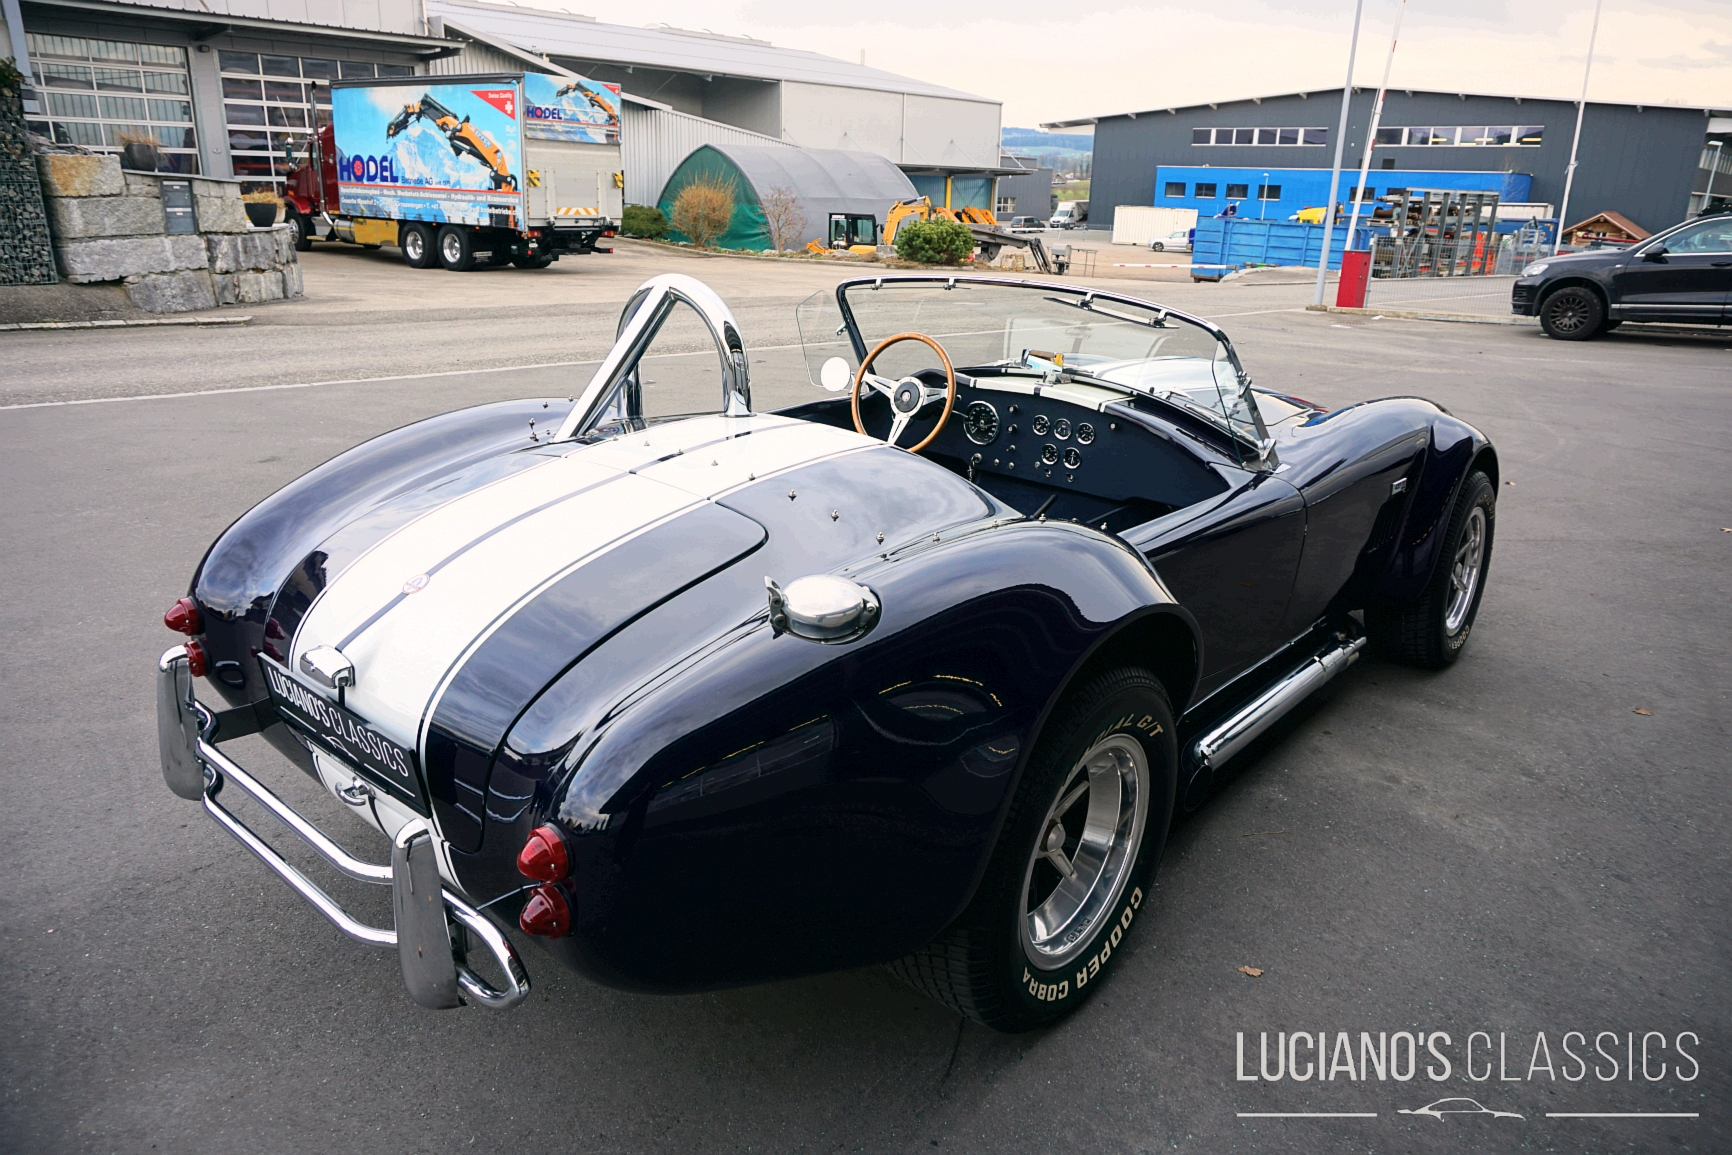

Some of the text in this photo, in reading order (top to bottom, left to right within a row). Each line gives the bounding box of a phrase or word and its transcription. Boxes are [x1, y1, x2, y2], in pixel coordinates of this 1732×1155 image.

[526, 105, 563, 120] HODEL
[339, 154, 399, 183] HODEL
[401, 176, 424, 185] Betriebe
[424, 177, 434, 186] AG
[267, 666, 409, 777] LUCIANO'S CLASSICS
[1136, 714, 1164, 737] G/T
[1022, 886, 1143, 1002] COOPER COBRA
